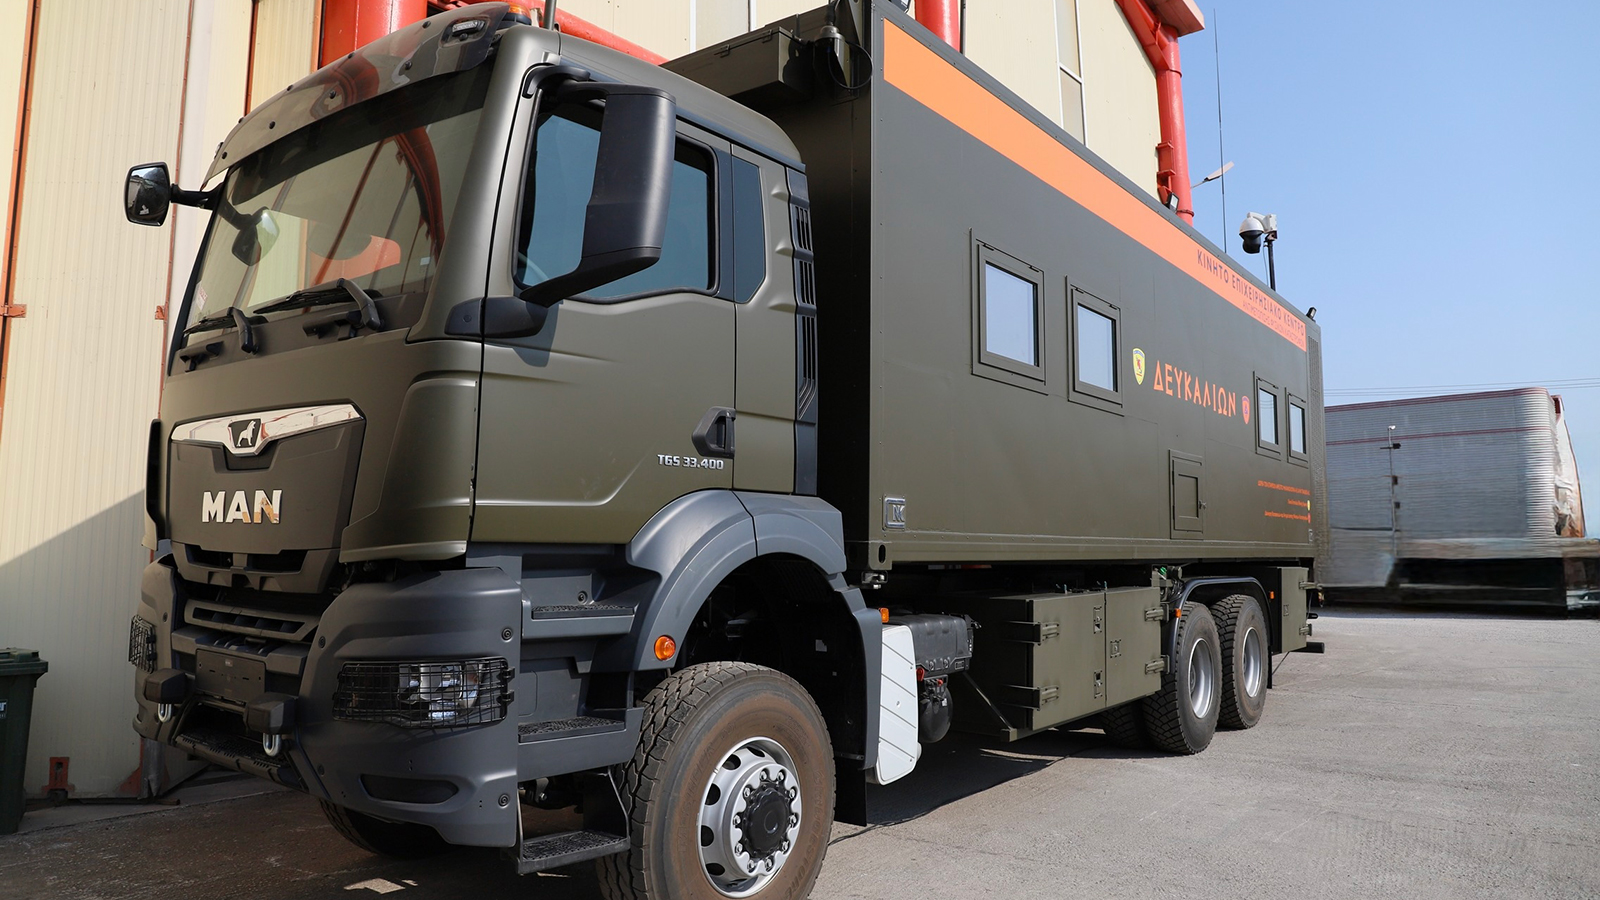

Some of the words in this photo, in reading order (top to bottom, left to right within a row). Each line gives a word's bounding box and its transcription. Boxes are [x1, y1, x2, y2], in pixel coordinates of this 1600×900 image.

[1197, 249, 1229, 284] ΚΙΝΗΤΟ
[1232, 274, 1281, 321] ΕΠΙΧΕΙΡΗΣΙΑΚΟ
[1283, 312, 1304, 337] ΚΕΝΤΡΟ
[1153, 360, 1236, 417] ΔΕΥΚΑΛΙΩΝ
[657, 454, 680, 467] TGS
[683, 456, 724, 470] 33.400
[202, 489, 282, 524] MAN
